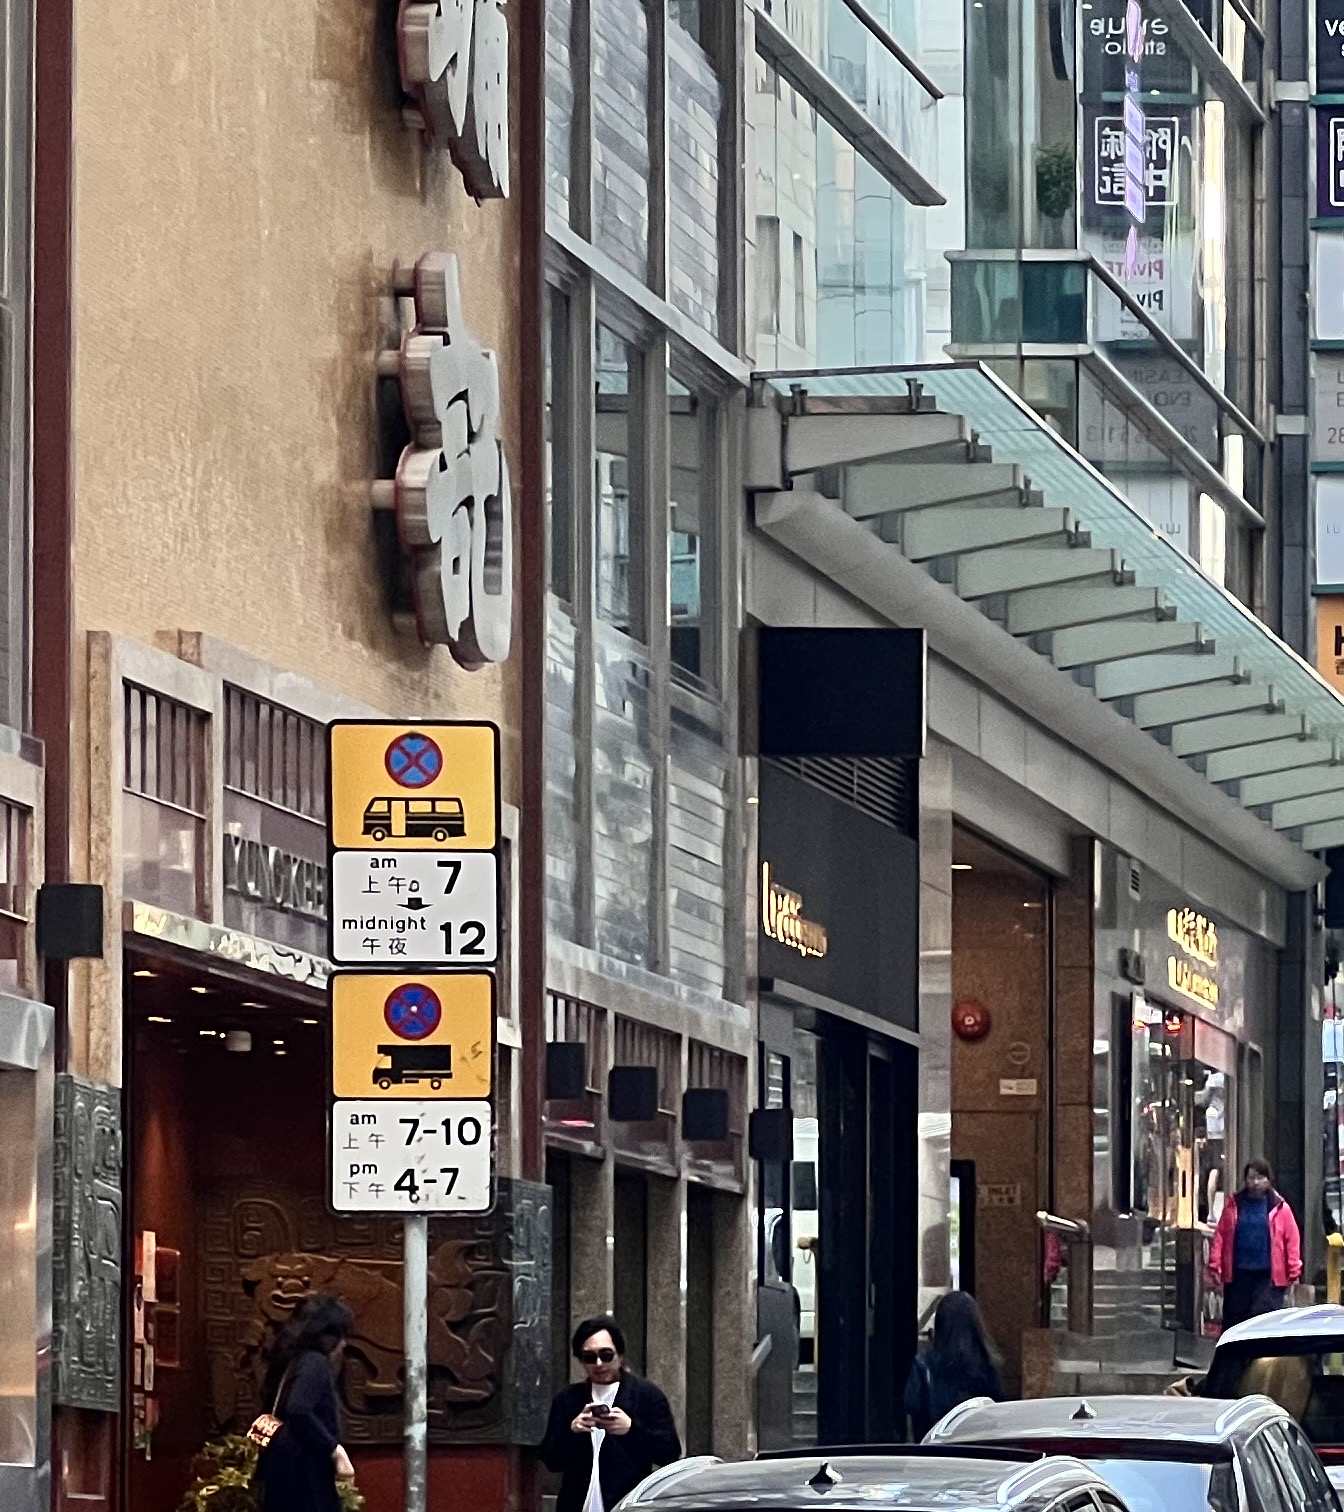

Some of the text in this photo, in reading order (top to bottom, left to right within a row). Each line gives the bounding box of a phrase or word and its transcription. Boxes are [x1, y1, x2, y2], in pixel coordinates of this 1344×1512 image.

[361, 875, 407, 894] 上午
[370, 858, 461, 894] am 7
[342, 915, 486, 955] midnight 12
[362, 937, 407, 955] 午夜
[342, 1132, 385, 1149] 上午
[350, 1113, 482, 1146] am 7-10
[342, 1182, 386, 1199] 下午
[350, 1163, 459, 1195] pm 4-7
